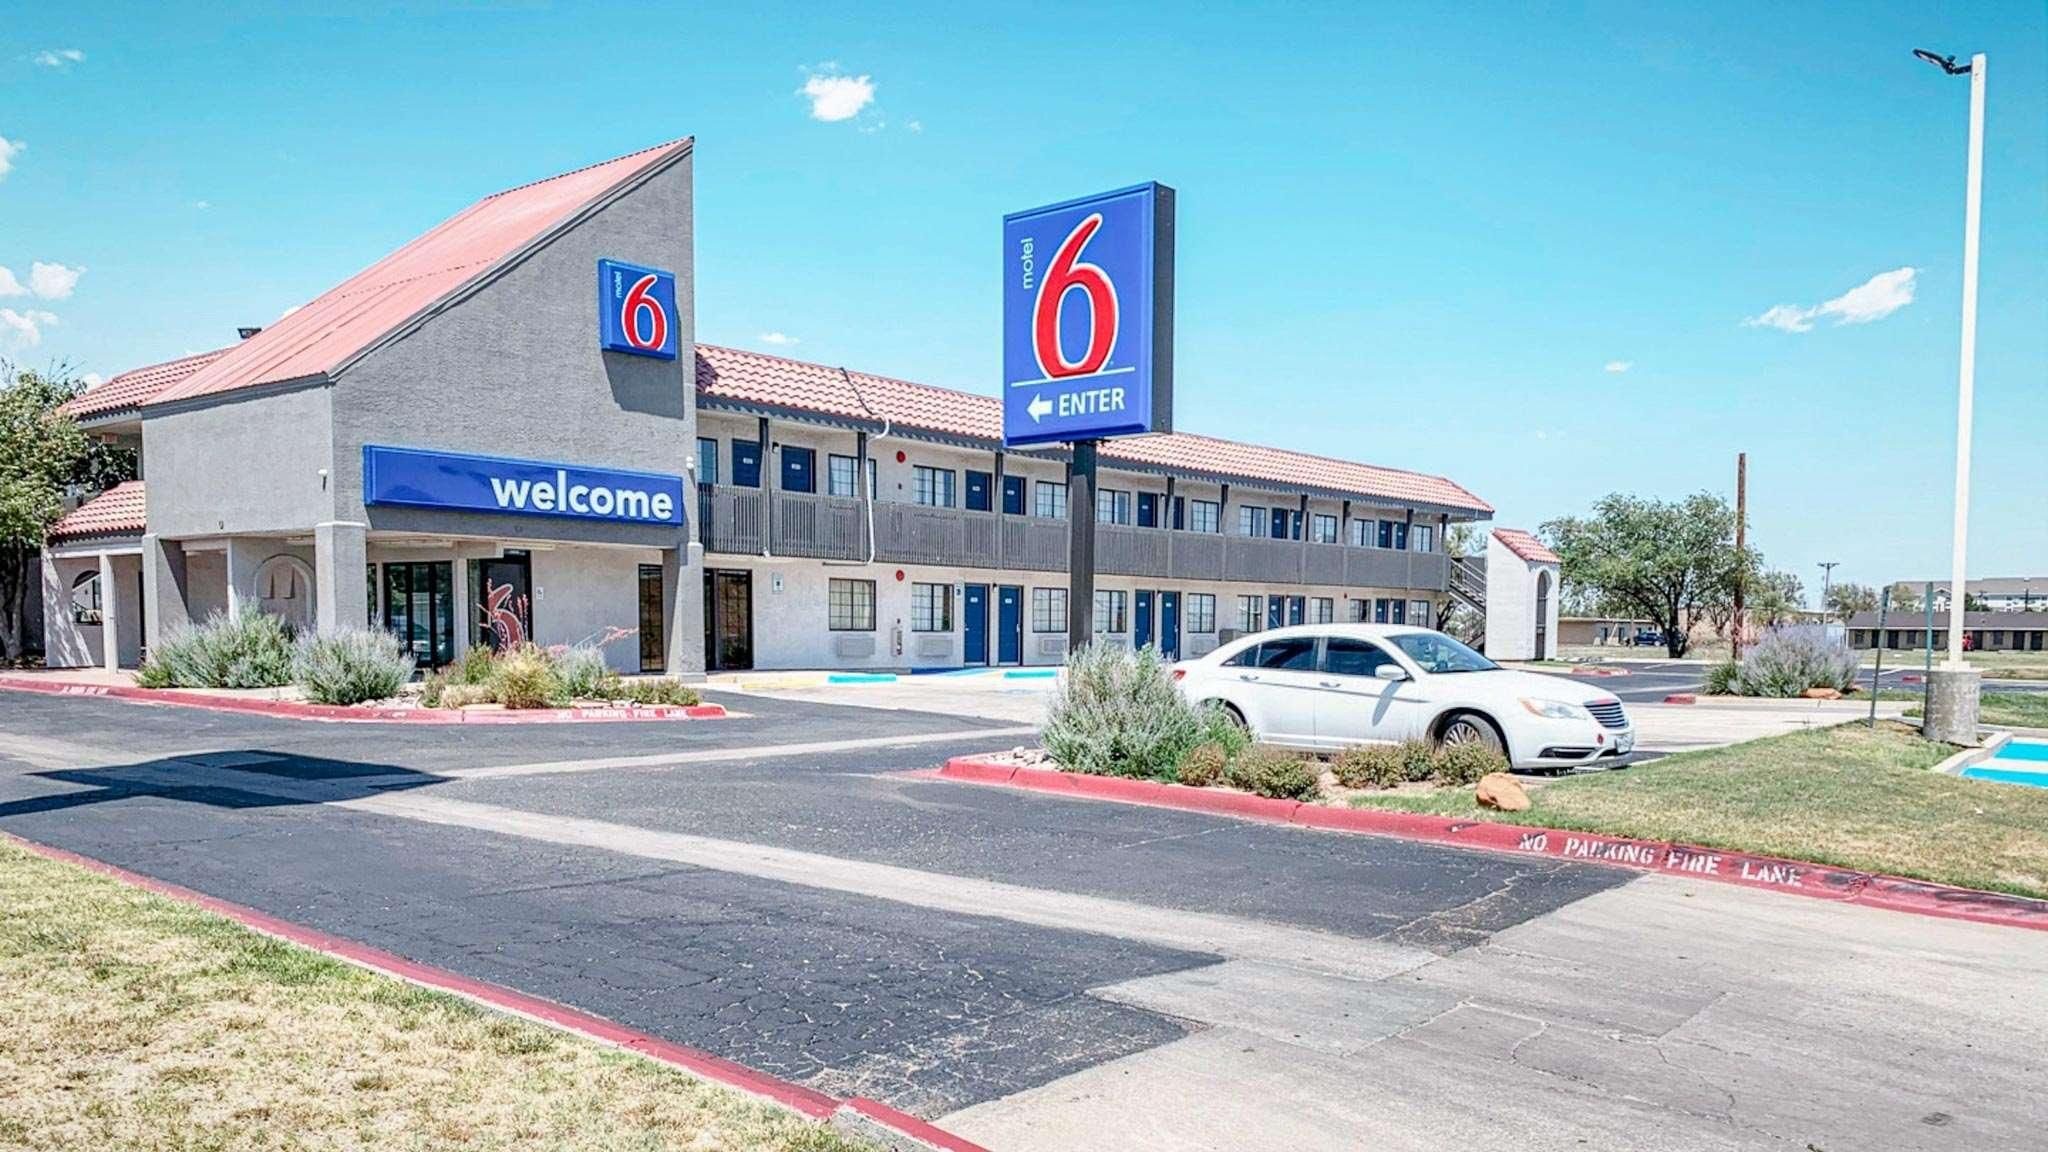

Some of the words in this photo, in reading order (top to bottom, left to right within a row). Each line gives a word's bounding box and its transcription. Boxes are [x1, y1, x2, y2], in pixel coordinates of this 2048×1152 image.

[613, 271, 623, 299] motel
[1021, 237, 1034, 290] motel
[621, 274, 668, 351] 6
[1032, 212, 1120, 381] 6
[1058, 387, 1125, 417] ENTER
[490, 470, 673, 520] welcome
[581, 708, 626, 719] PARKING
[1519, 832, 1548, 852] NO
[1563, 837, 1654, 865] PARKING
[1666, 851, 1723, 875] FIRE
[1741, 860, 1802, 887] LANE
